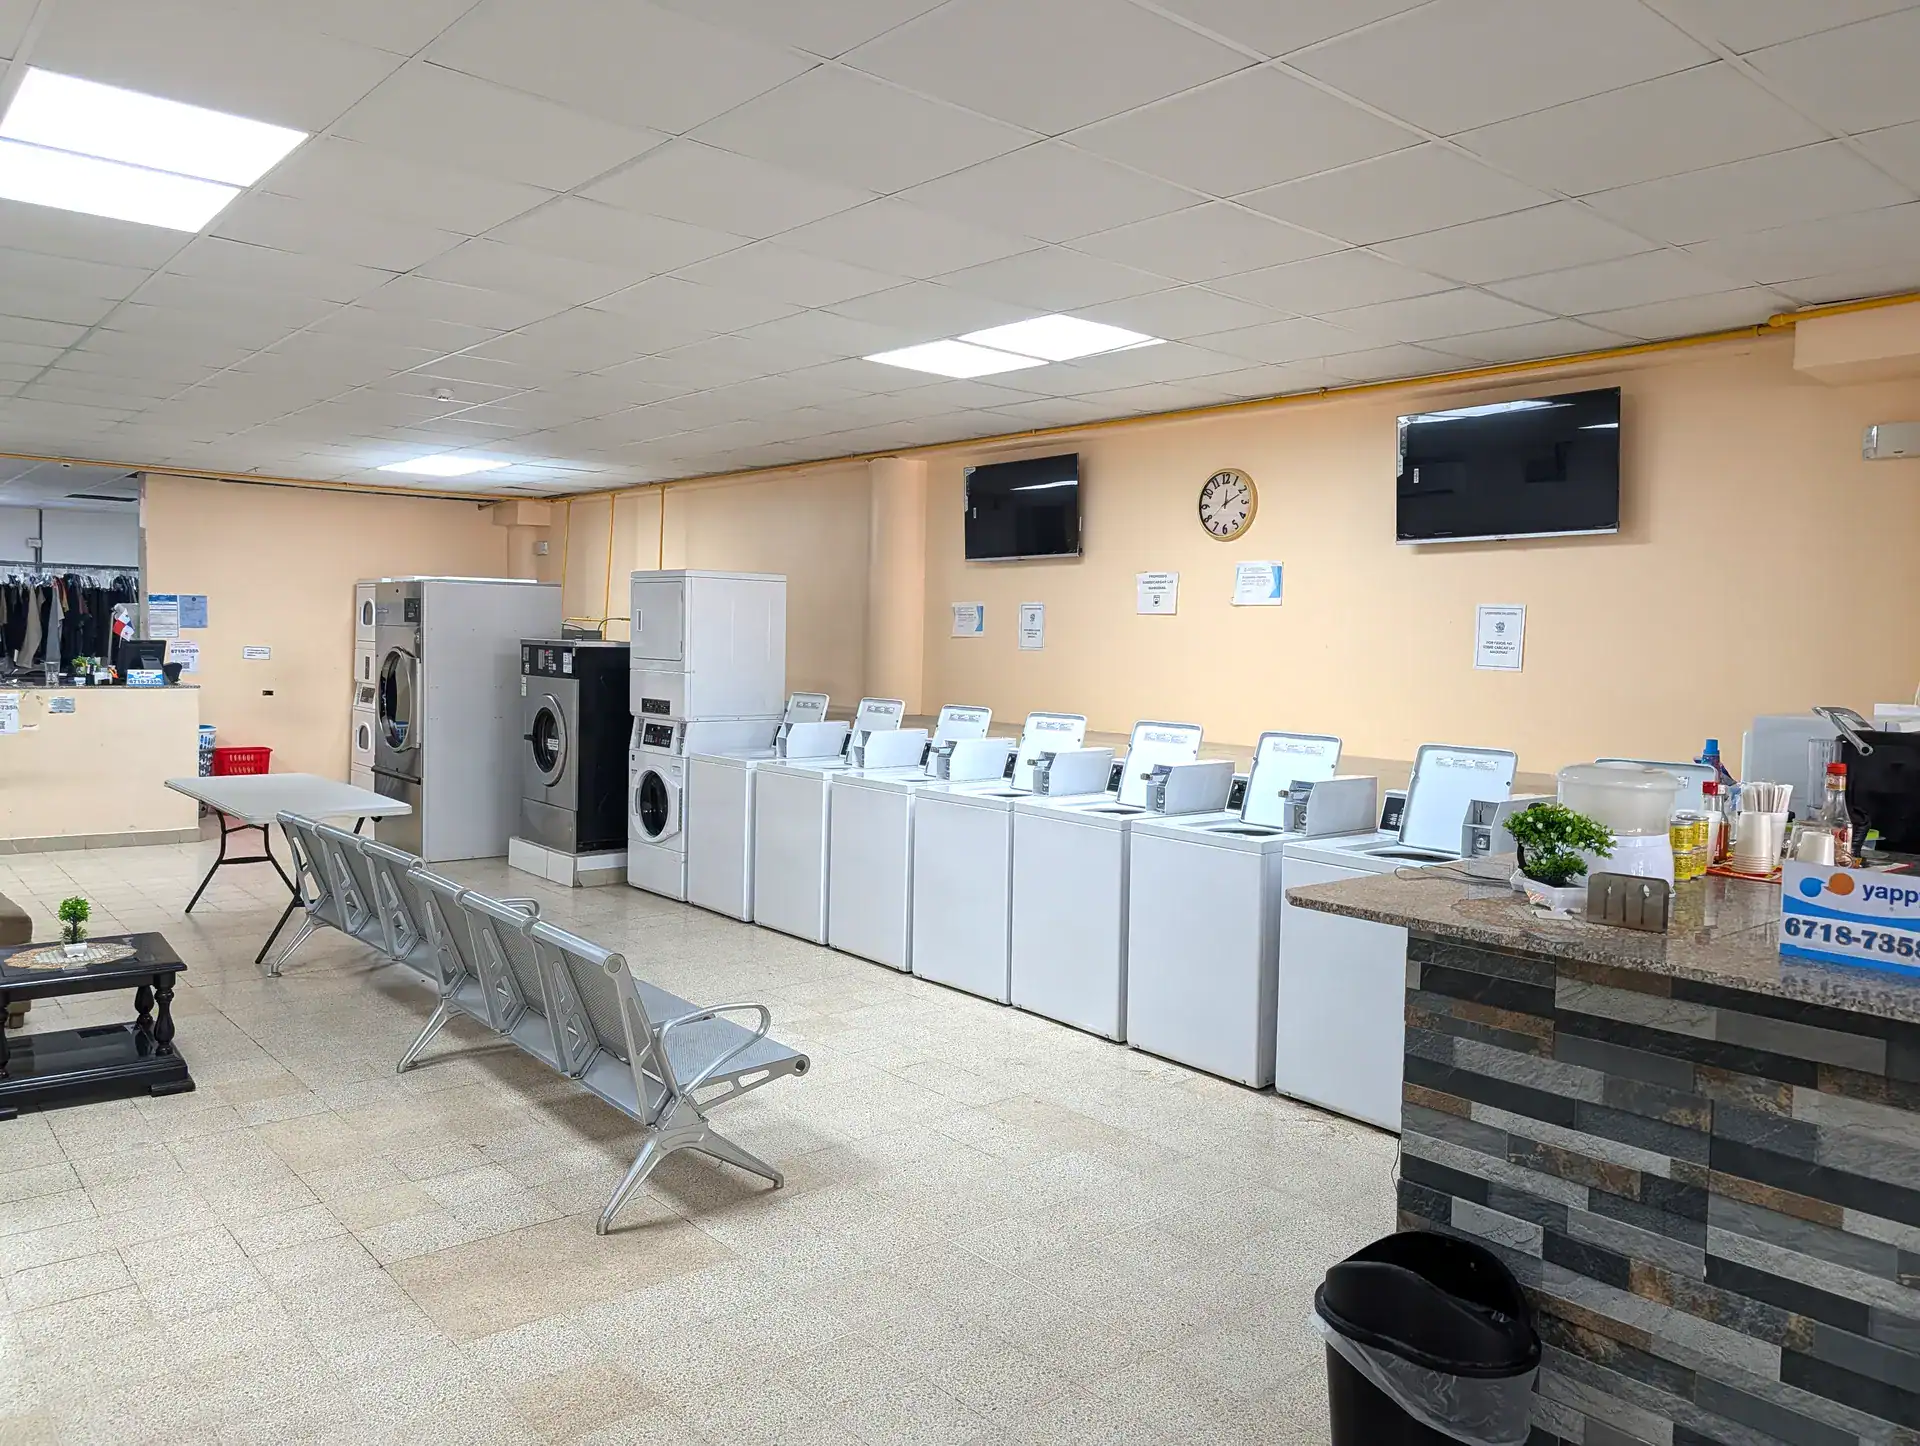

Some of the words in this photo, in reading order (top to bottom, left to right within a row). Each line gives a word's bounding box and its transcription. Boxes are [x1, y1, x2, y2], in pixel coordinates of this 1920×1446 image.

[1211, 478, 1220, 490] 11
[1222, 473, 1231, 485] 12
[1233, 475, 1239, 486] 1
[1204, 488, 1214, 499] 10
[1238, 484, 1248, 494] 2
[1203, 514, 1213, 523] 8
[1212, 520, 1220, 532] 7
[1222, 523, 1228, 535] 6
[1231, 519, 1239, 530] 5
[1862, 884, 1920, 907] yapp
